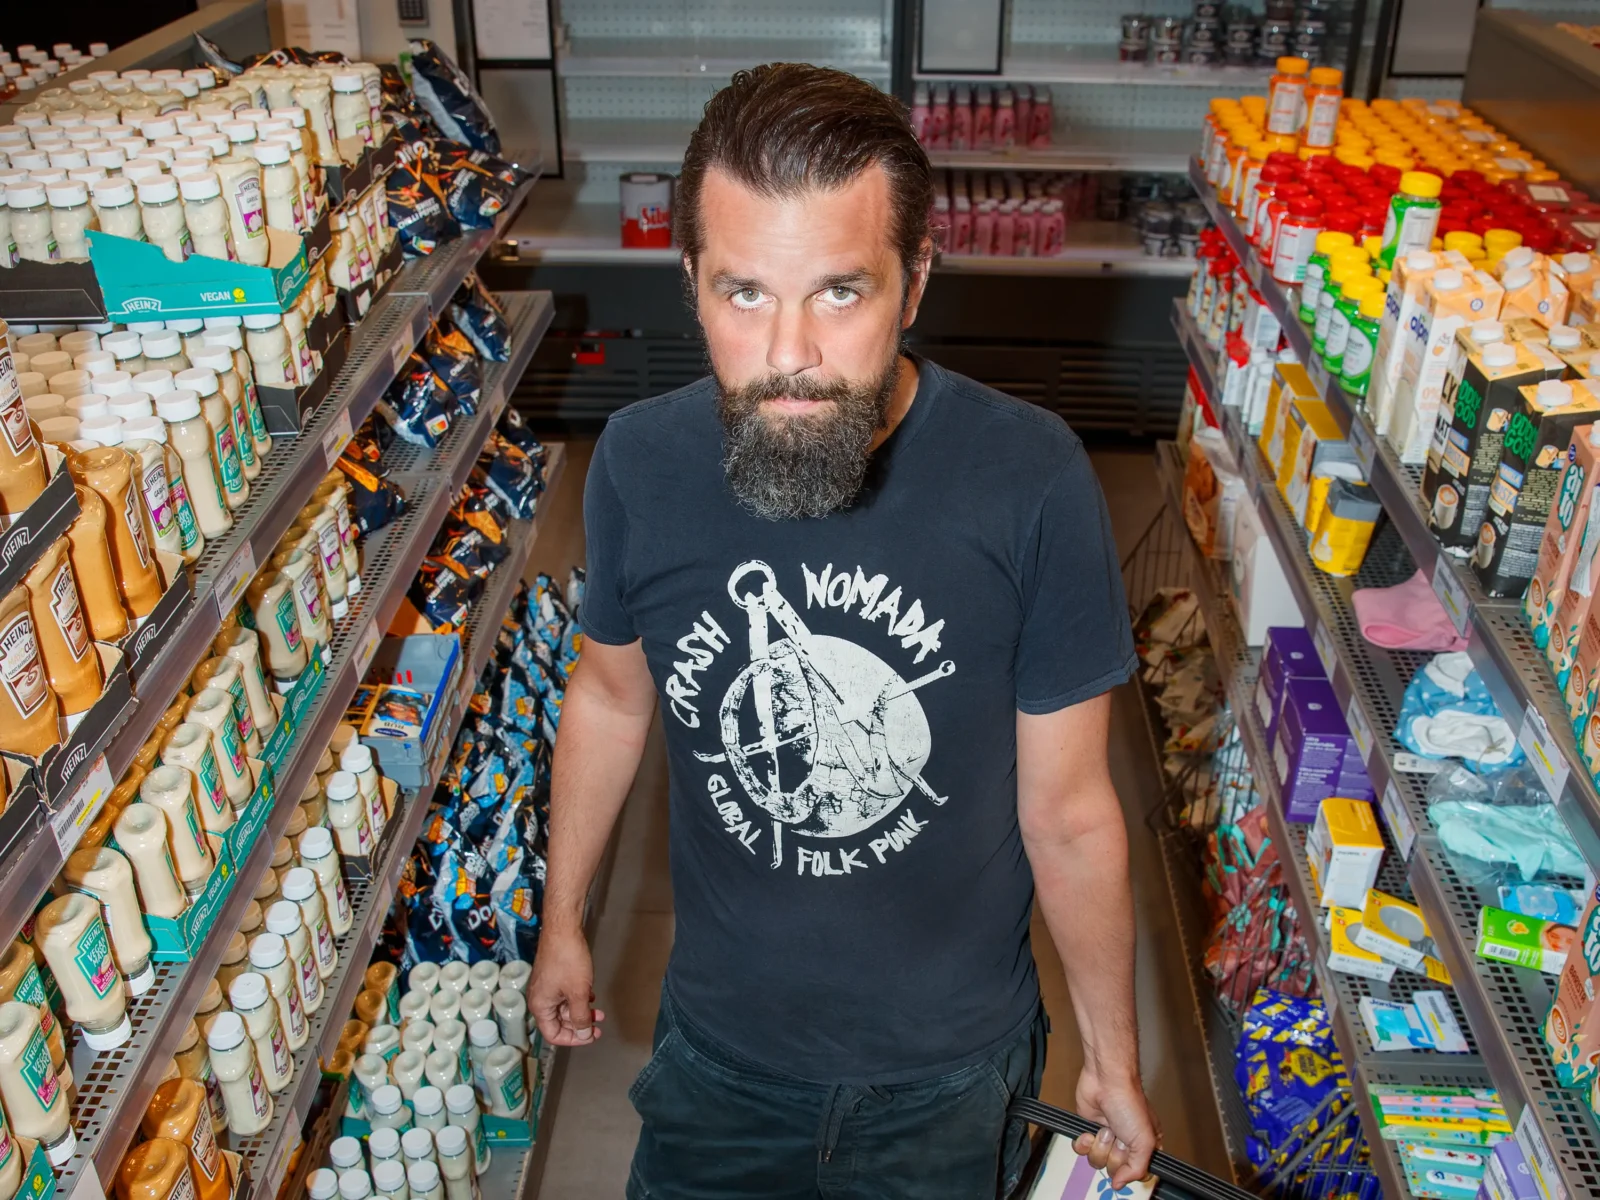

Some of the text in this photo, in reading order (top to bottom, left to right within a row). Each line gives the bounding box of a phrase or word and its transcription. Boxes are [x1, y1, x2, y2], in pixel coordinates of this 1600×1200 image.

[126, 300, 160, 312] HEINZ
[200, 291, 231, 302] VEGAN
[0, 357, 14, 380] EINZ
[6, 532, 29, 561] HEINZ
[4, 621, 29, 651] HEINZ
[137, 627, 156, 655] HEINZ
[665, 563, 945, 729] CRASH NOMADA
[64, 747, 86, 780] HEINZ
[250, 795, 263, 818] VEGAN
[238, 823, 252, 849] HEINZ
[707, 774, 930, 876] GLOBAL FOLK PUNK
[207, 877, 222, 901] VEGAN
[192, 905, 209, 933] HEINZ
[83, 924, 102, 949] HEINZ
[87, 936, 106, 963] VEGAN
[92, 945, 108, 967] MAYO
[20, 969, 37, 997] HEINZ
